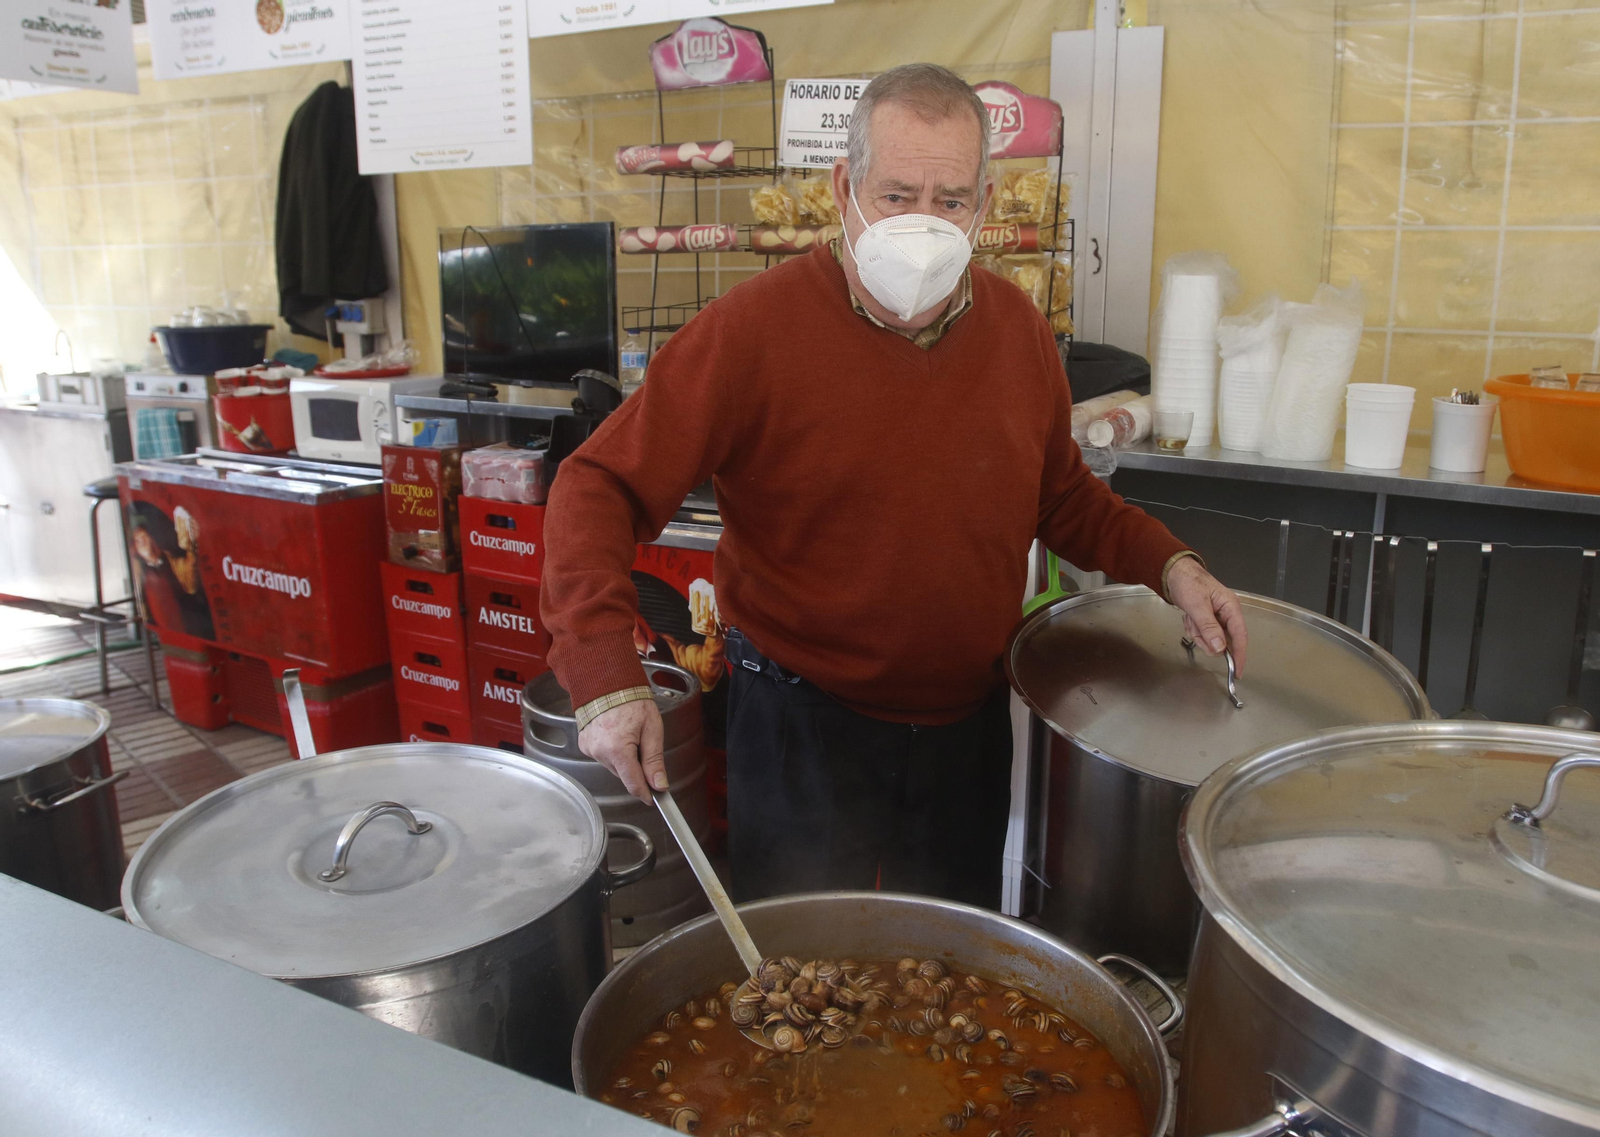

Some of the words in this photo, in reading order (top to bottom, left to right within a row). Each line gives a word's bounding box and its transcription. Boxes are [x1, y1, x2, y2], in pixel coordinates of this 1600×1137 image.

[575, 6, 599, 14] Desde
[600, 2, 617, 11] 1991
[682, 28, 731, 64] Lay's
[790, 83, 841, 100] HORARIO
[844, 85, 860, 101] DE
[989, 104, 1018, 134] y's
[787, 138, 823, 149] PROHIBIDA
[824, 140, 833, 150] LA
[803, 154, 808, 163] A
[809, 154, 838, 164] MENORE
[685, 223, 727, 253] Lay's
[410, 499, 437, 517] Fases
[469, 530, 536, 557] Cruzcampo
[222, 555, 311, 599] Cruzcampo
[391, 594, 452, 619] Cruzcampo
[478, 606, 536, 634] AMSTEL
[400, 665, 460, 691] Cruzcampo
[482, 681, 523, 705] AMST
